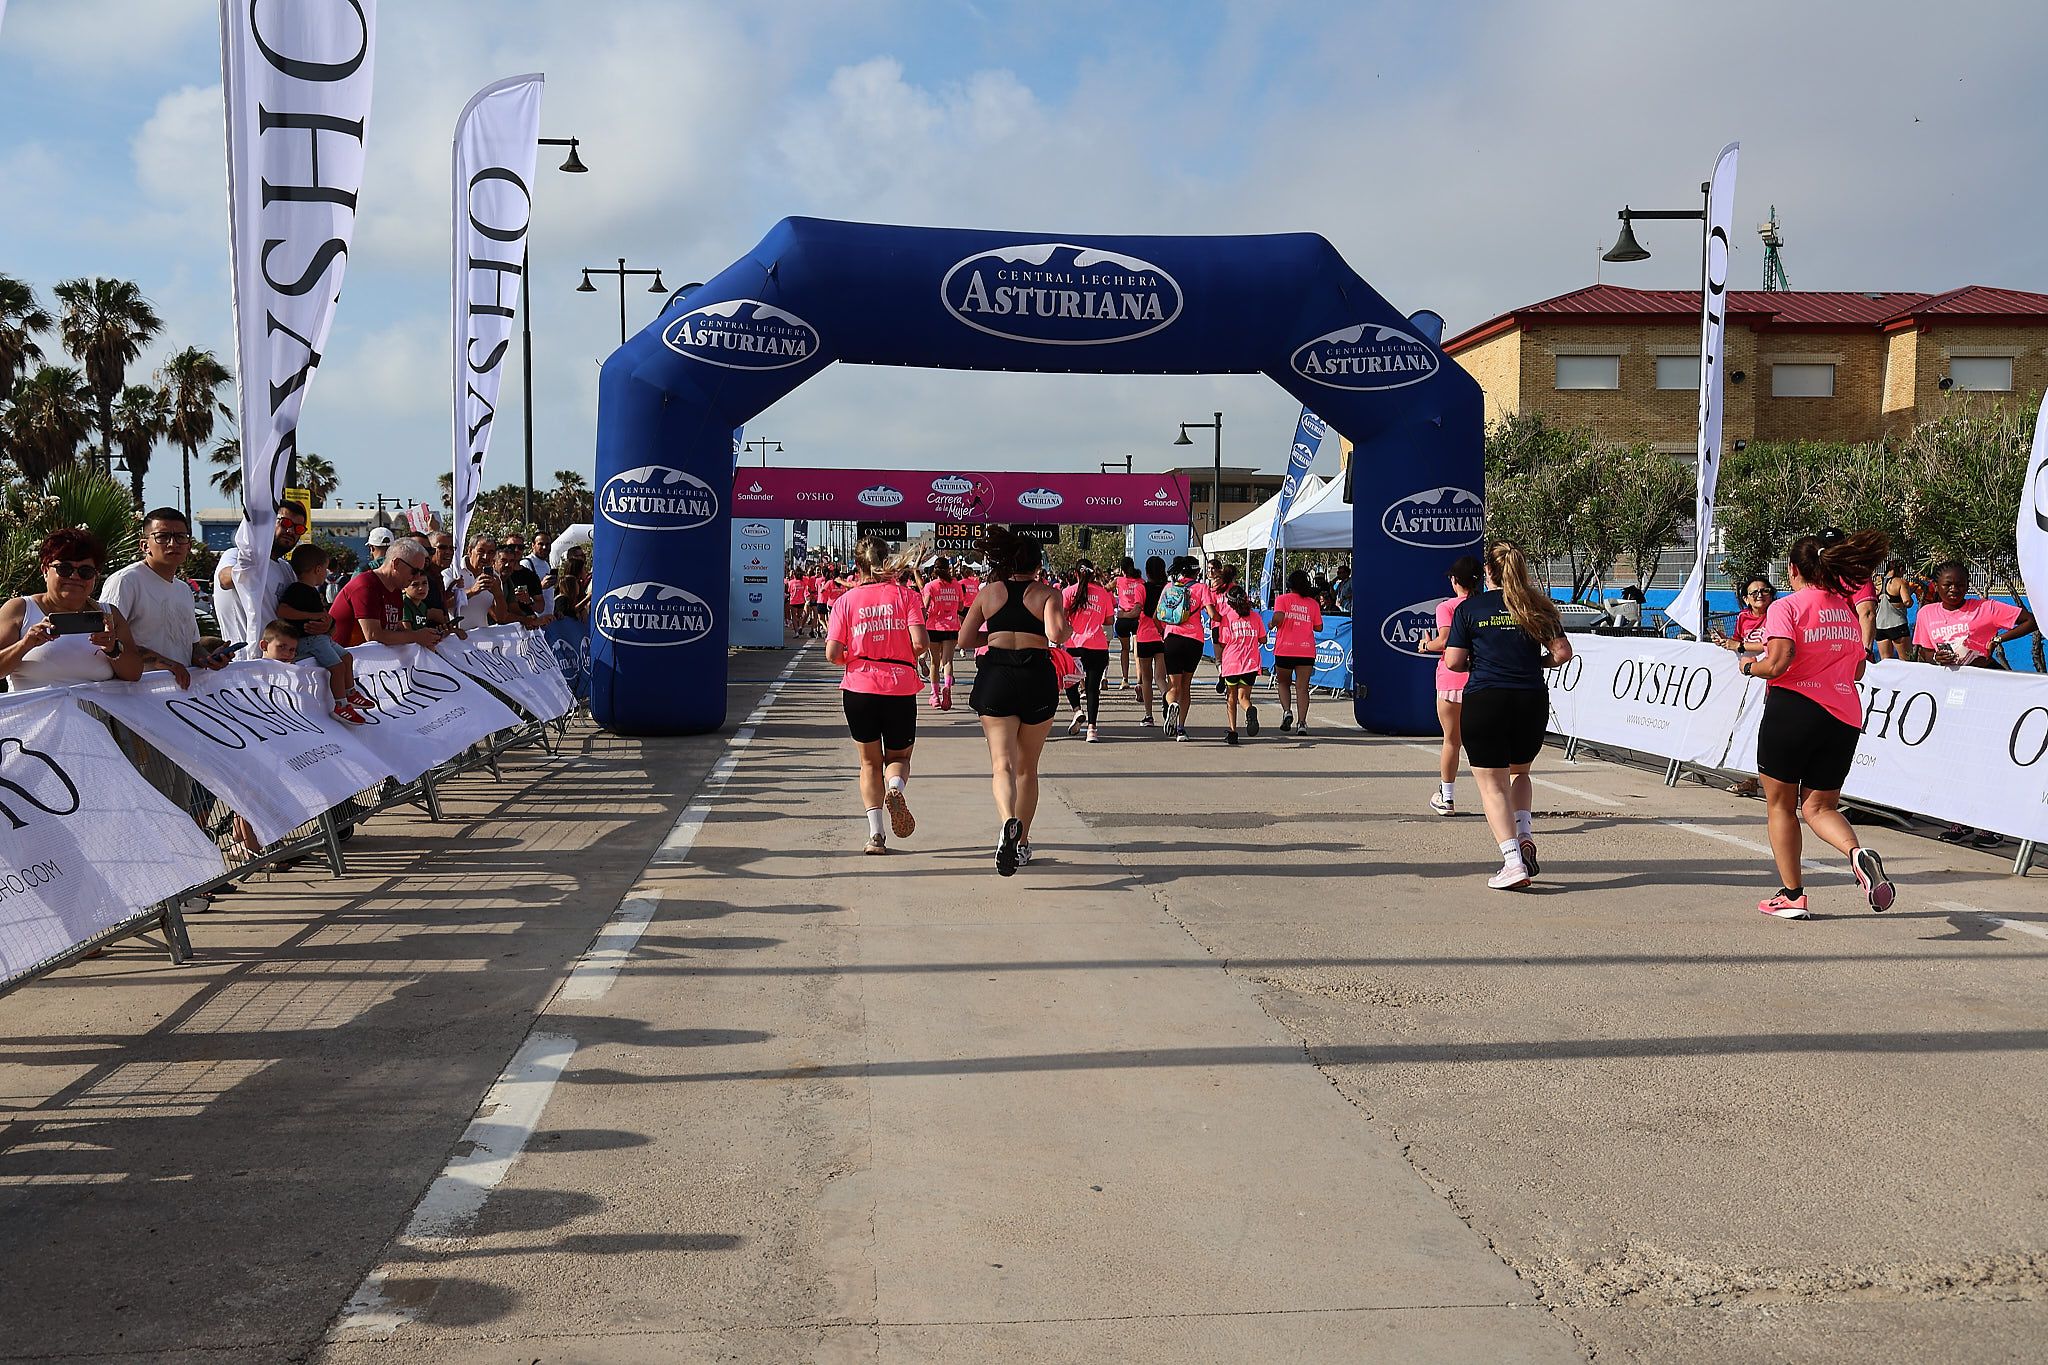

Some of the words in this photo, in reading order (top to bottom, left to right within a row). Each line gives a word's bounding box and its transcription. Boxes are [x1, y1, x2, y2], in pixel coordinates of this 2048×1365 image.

[998, 269, 1074, 284] CENTRAL
[1081, 274, 1158, 287] LECHERA
[958, 269, 1165, 321] ASTURIANA
[699, 319, 751, 331] CENTRAL
[756, 324, 807, 337] LECHERA
[671, 320, 807, 356] ASTURIANA
[1326, 346, 1377, 356] CENTRAL
[1381, 344, 1423, 353] LECHERA
[1302, 350, 1433, 375] ASTURIANA
[620, 486, 663, 495] CENTRAL
[666, 488, 708, 498] LECHERA
[737, 492, 775, 502] Santander
[796, 492, 835, 502] OYSHO
[926, 492, 963, 504] Carrera
[604, 487, 711, 517] ASTURIANA
[1085, 496, 1122, 506] OYSHO
[1143, 499, 1179, 507] Santander
[947, 503, 975, 520] Mujer
[864, 527, 901, 536] OYSHO
[740, 543, 771, 551] OYSHO
[614, 602, 656, 611] CENTRAL
[660, 604, 703, 613] LECHERA
[858, 603, 894, 620] SOMOS
[599, 603, 706, 632] ASTURIANA
[1818, 608, 1852, 624] SOMOS
[1931, 623, 1970, 639] CARRERA
[1612, 659, 1712, 711] OYSHO
[165, 684, 325, 750] OYSHO
[0, 859, 64, 903] HO.COM
